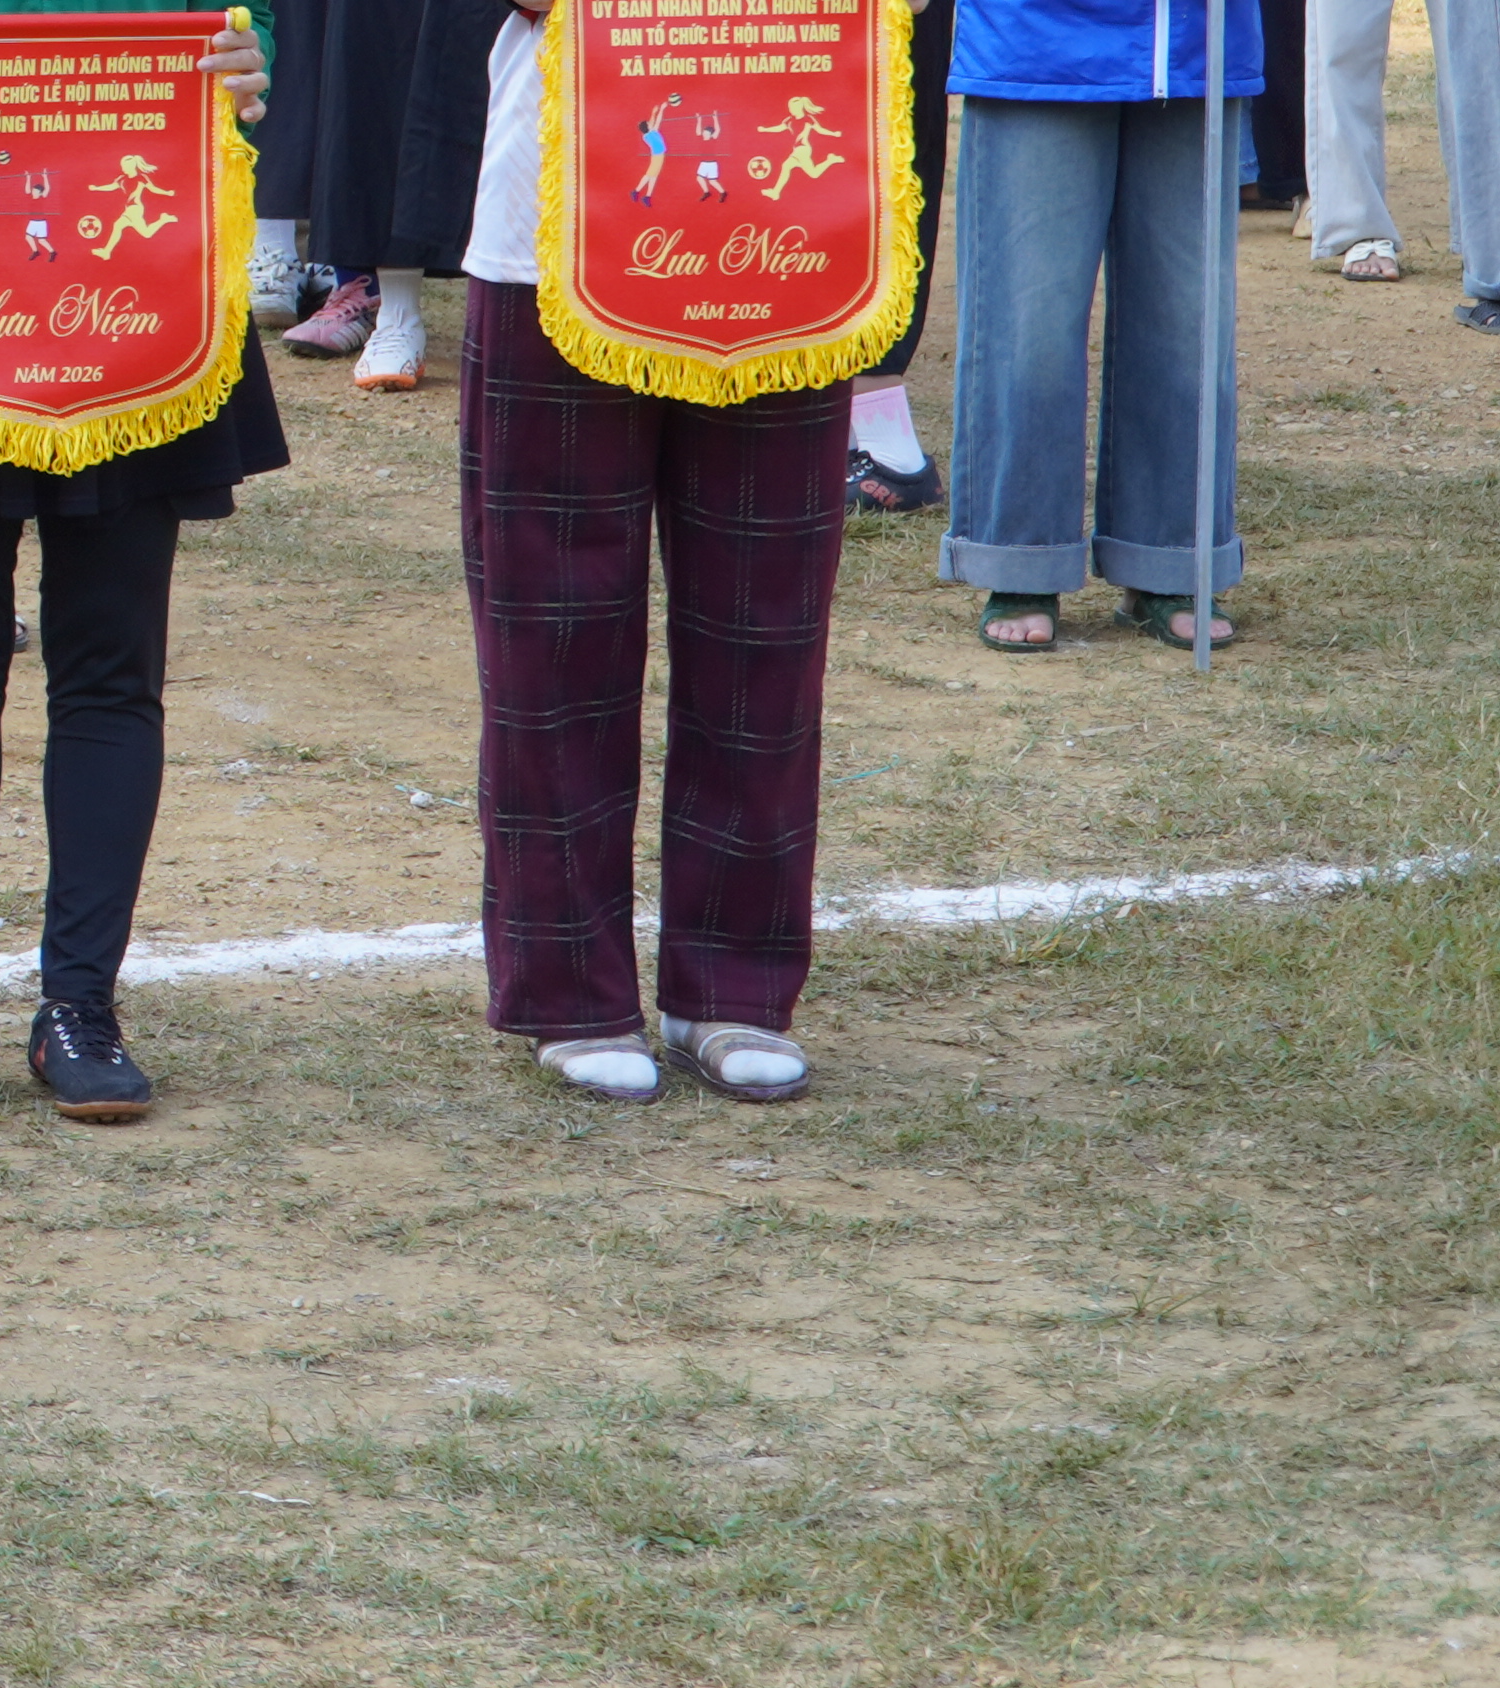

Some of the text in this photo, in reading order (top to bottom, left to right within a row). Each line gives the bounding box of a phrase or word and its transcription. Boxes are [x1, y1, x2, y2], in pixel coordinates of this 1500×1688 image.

[617, 0, 654, 19] BAN
[610, 19, 840, 48] BAN TỔ CHỨC LỄ HỘI MÙA VÀNG
[39, 54, 76, 76] DÂN
[78, 54, 102, 75] XÃ
[105, 51, 153, 74] HỒNG
[156, 52, 194, 73] THÁI
[620, 51, 833, 77] XÃ HỒNG THÁI NĂM 2026
[0, 82, 40, 104] CHỨC
[43, 78, 62, 103] LỄ
[65, 80, 91, 106] HỘI
[94, 79, 130, 102] MÙA
[133, 79, 175, 101] VÀNG
[30, 110, 71, 133] THÁI
[75, 110, 118, 132] NĂM
[121, 112, 166, 131] 2026
[624, 223, 833, 281] Lưu Niệm
[48, 283, 164, 343] Niệm
[683, 300, 772, 321] NĂM 2026
[13, 363, 104, 384] NĂM 2026
